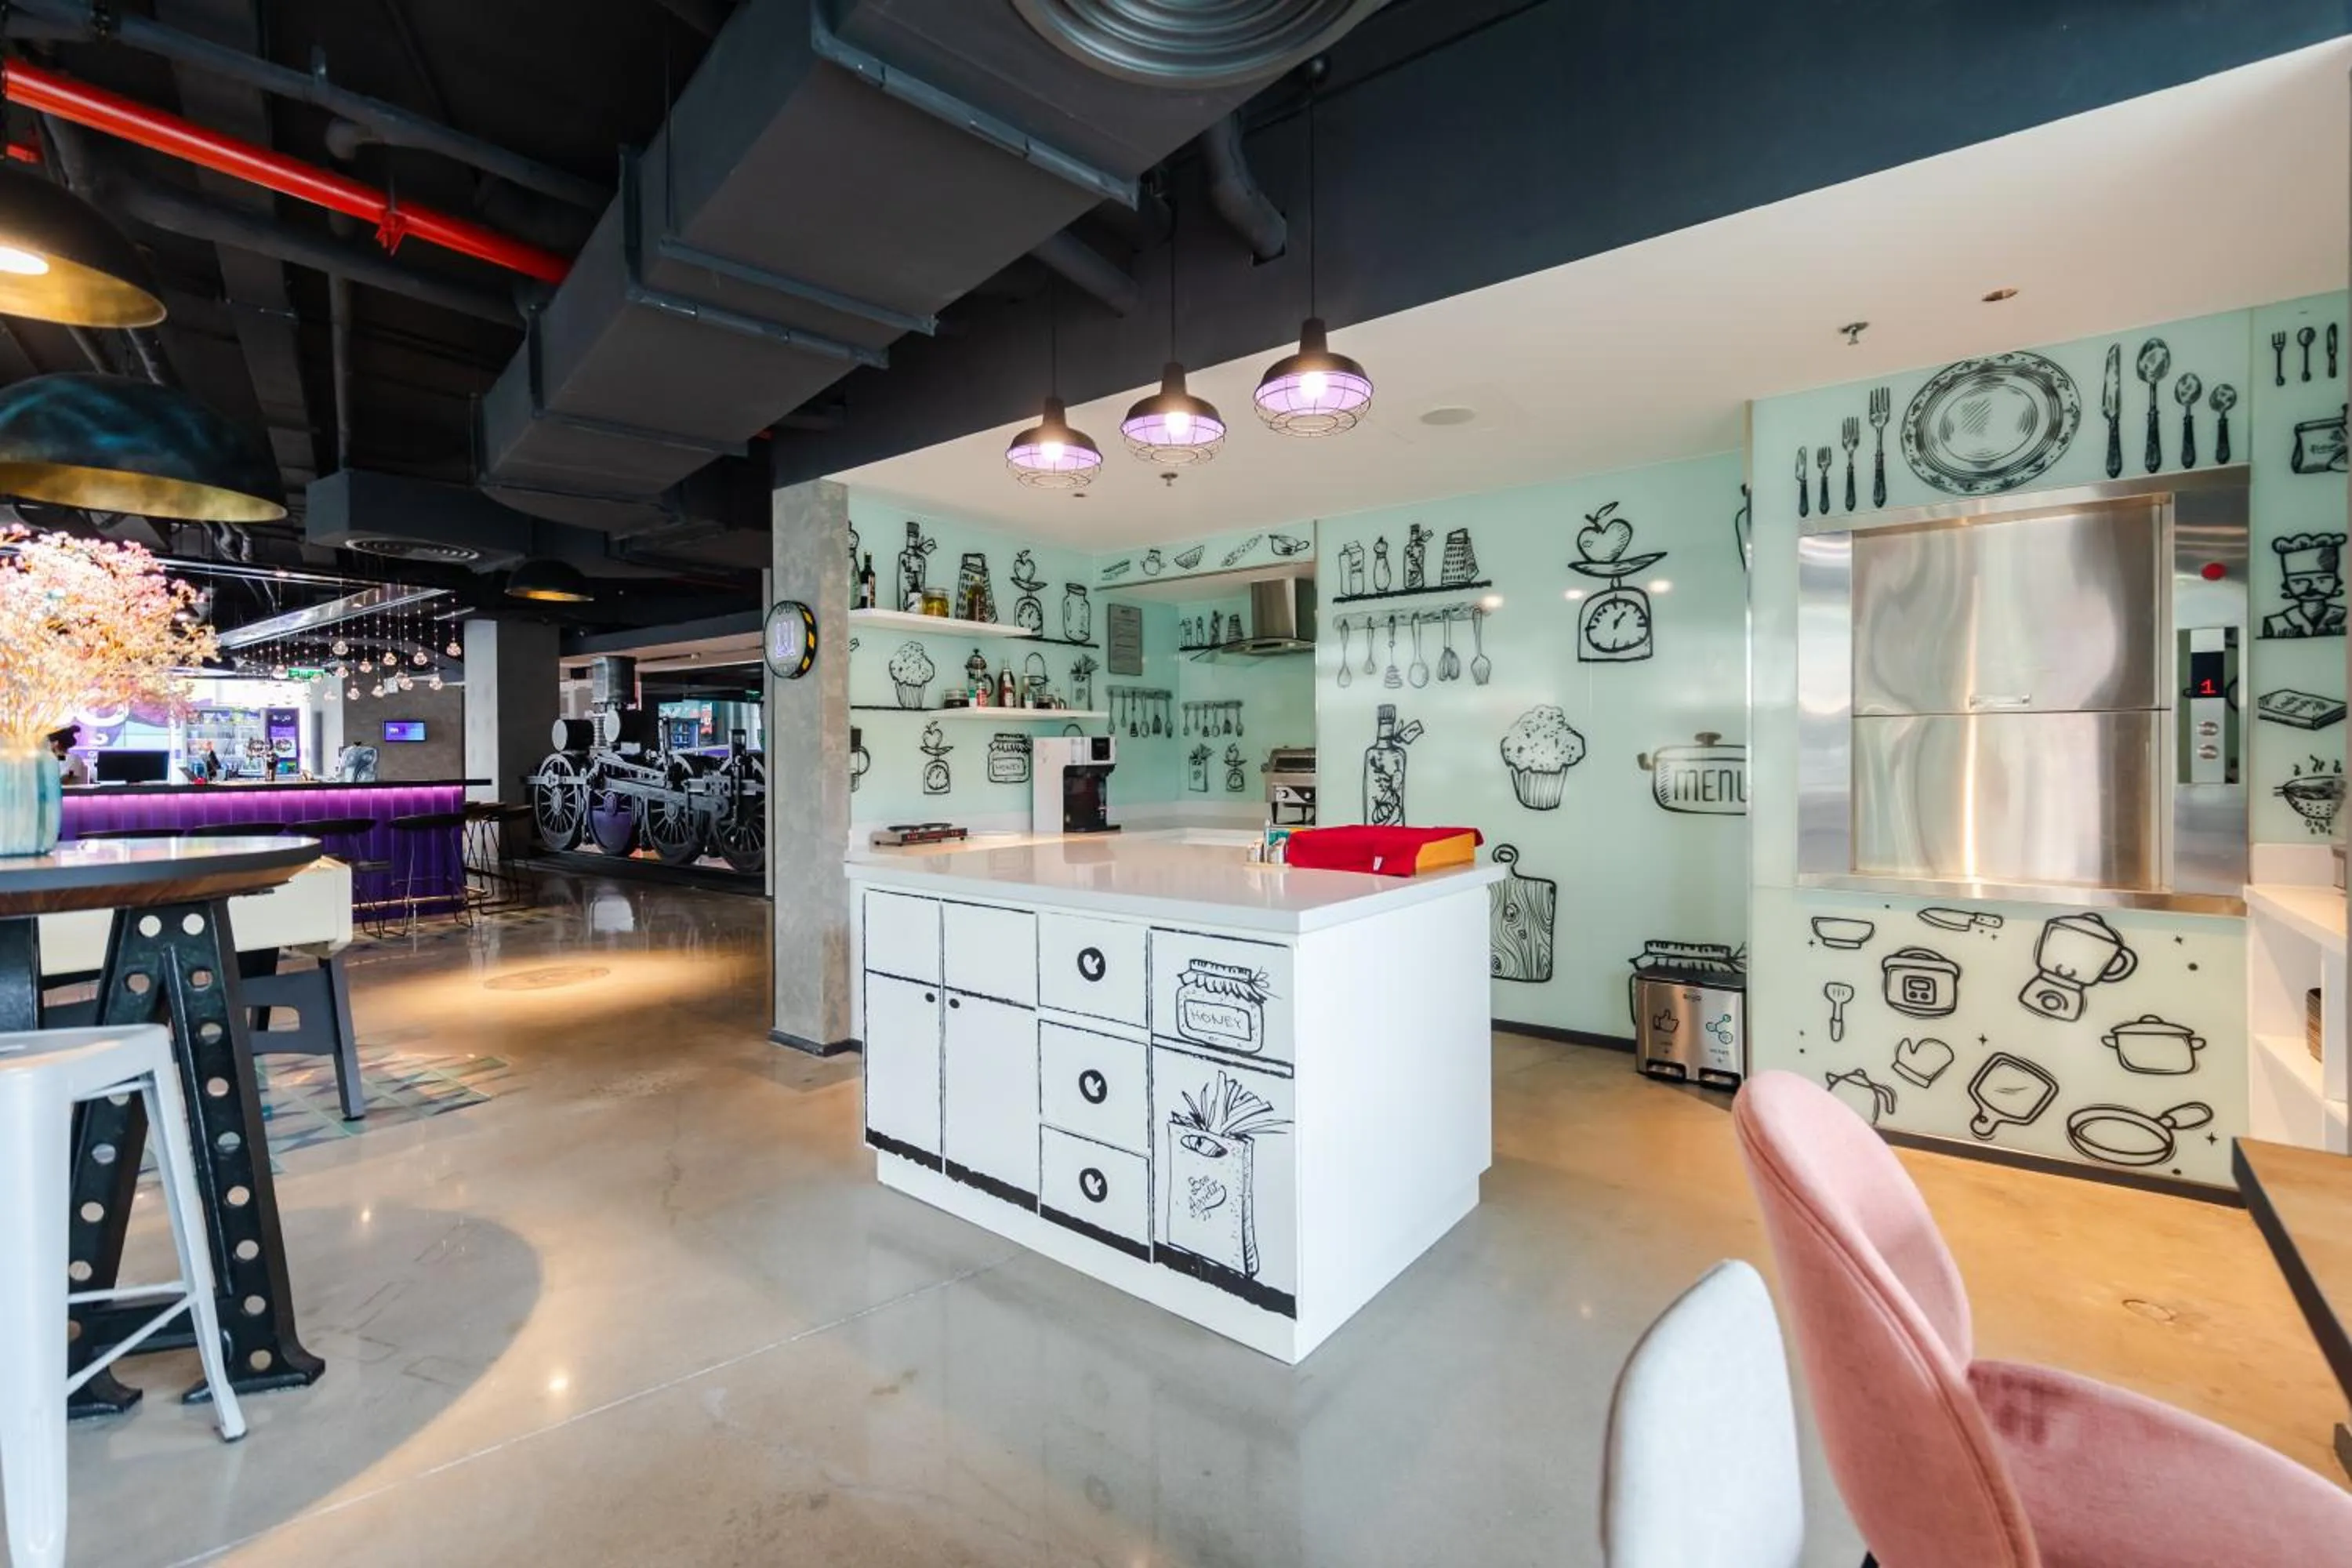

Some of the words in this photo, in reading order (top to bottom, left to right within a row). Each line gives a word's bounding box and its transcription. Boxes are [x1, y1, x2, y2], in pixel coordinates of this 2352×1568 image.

[2201, 678, 2217, 694] 1
[1674, 769, 1747, 802] MENU
[1192, 1009, 1242, 1029] HONEY
